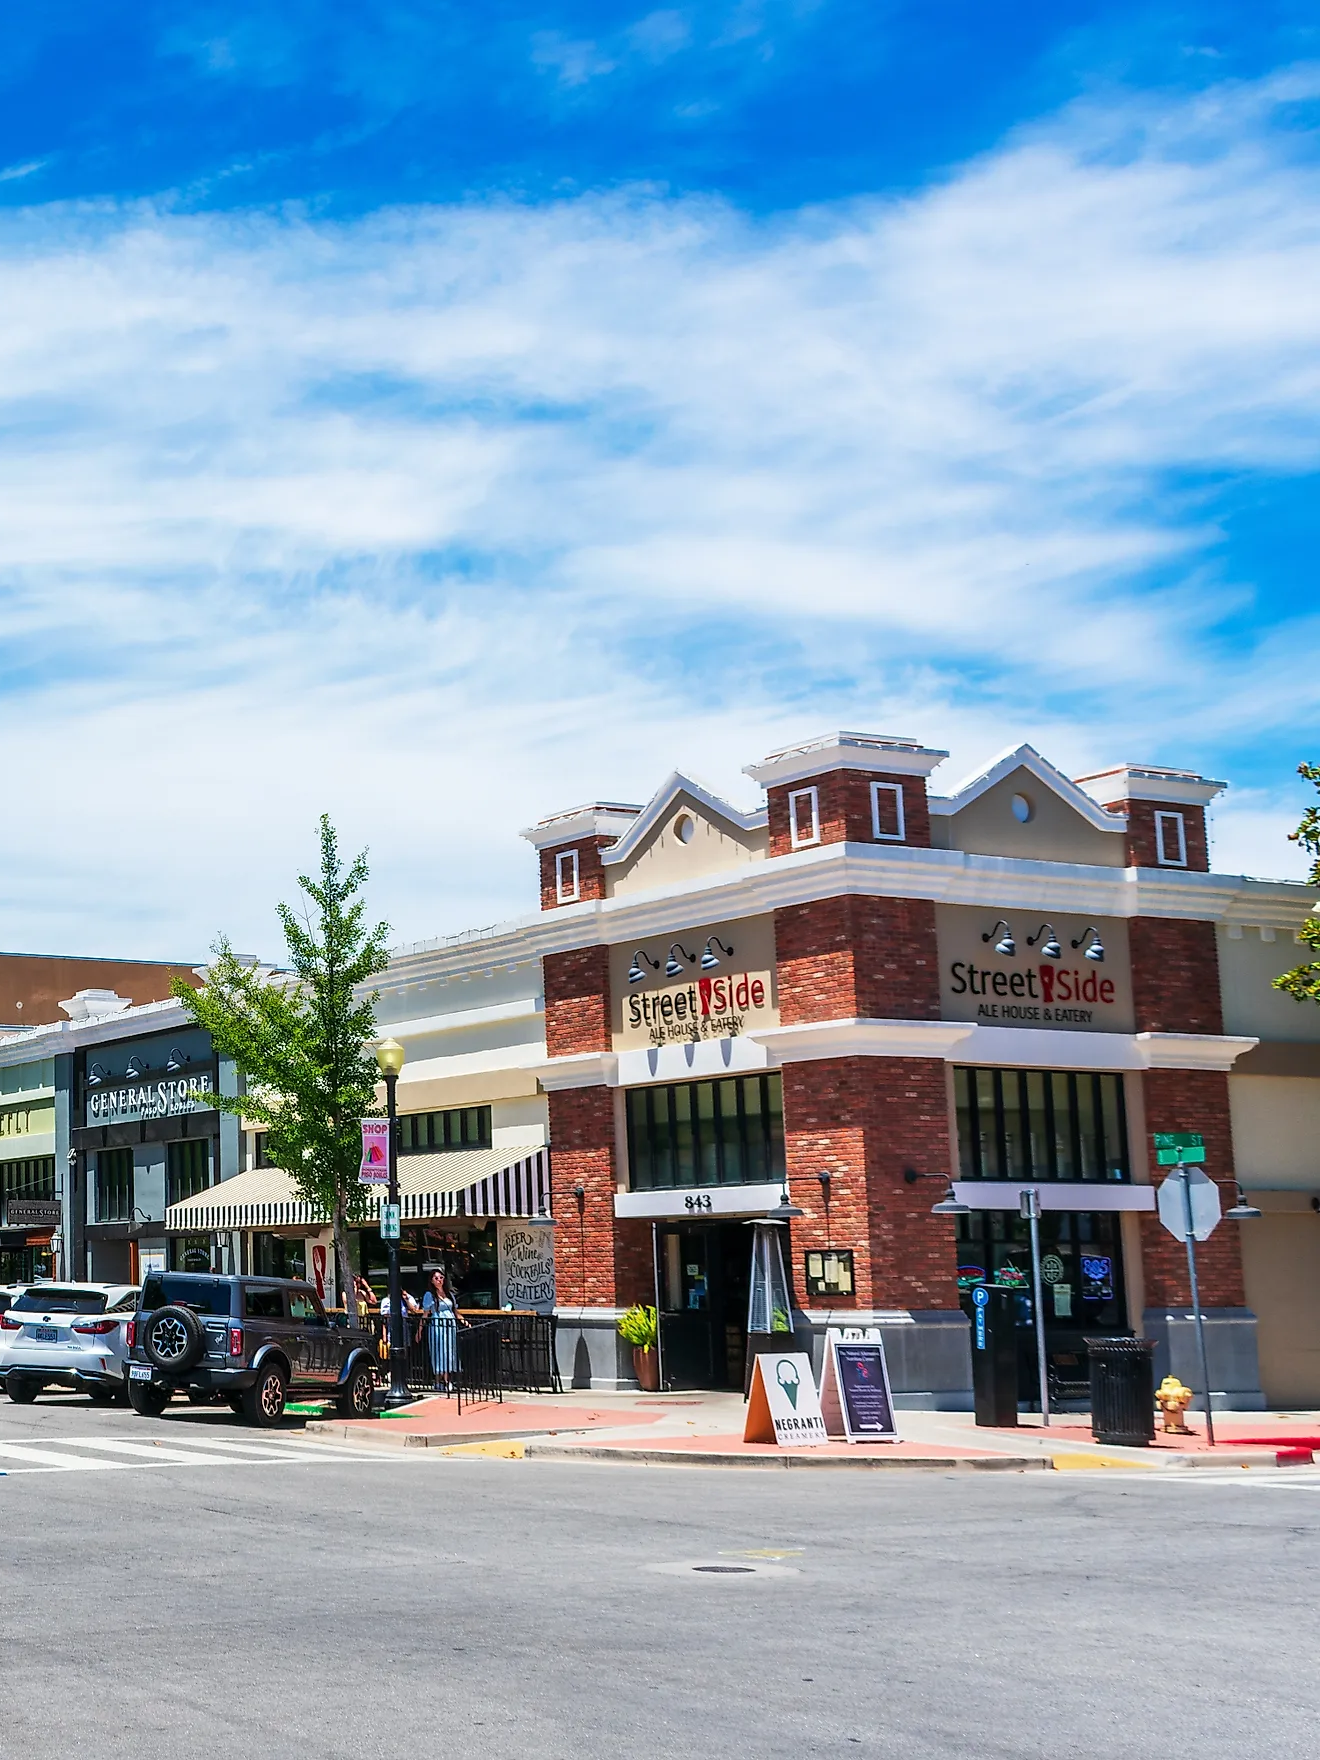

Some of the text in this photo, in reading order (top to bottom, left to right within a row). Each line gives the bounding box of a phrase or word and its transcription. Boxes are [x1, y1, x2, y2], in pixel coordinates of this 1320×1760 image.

[951, 962, 1115, 1004] Street Side
[629, 972, 765, 1025] Street Side
[977, 1004, 1093, 1023] ALE HOUSE & EATERY
[649, 1015, 745, 1040] ALE HOUSE & EATERY
[90, 1075, 209, 1114] GENERAL STORE
[170, 1100, 195, 1112] ROBLES
[362, 1124, 388, 1134] SHOP
[684, 1194, 712, 1209] 843
[503, 1231, 533, 1257] BEER
[1084, 1259, 1109, 1274] 805
[977, 1291, 984, 1303] P
[775, 1416, 824, 1431] NEGRANTI
[778, 1432, 825, 1440] CREAMERY
